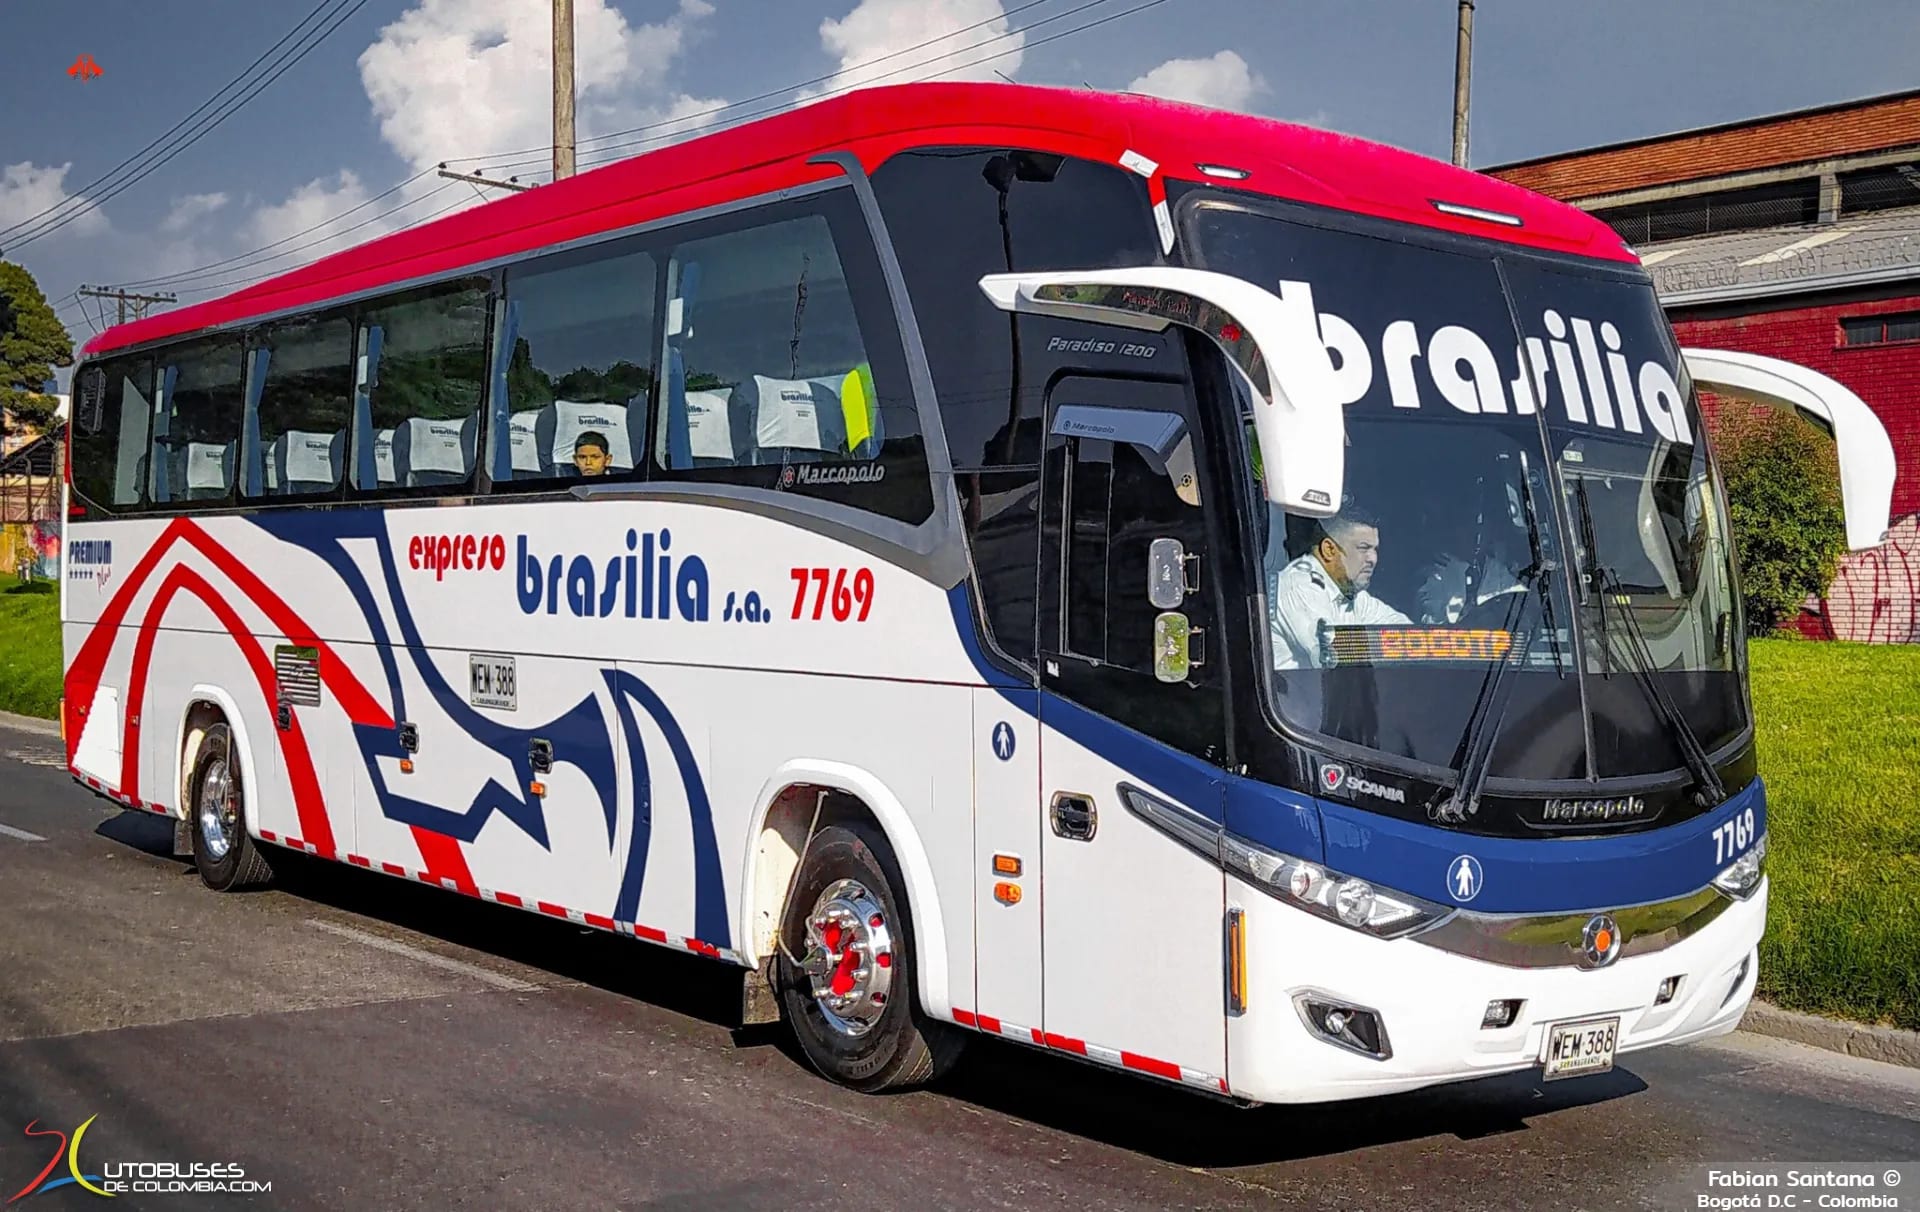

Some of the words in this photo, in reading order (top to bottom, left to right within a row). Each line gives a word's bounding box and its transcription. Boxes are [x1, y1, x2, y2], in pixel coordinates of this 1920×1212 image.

[1047, 337, 1116, 353] Paradiso
[1119, 343, 1157, 358] 1200
[1279, 279, 1694, 446] brasilia
[796, 464, 884, 485] Marcopolo
[69, 540, 112, 564] PREMIUM
[409, 534, 506, 581] expreso
[516, 528, 709, 622] brasilia
[723, 590, 771, 623] s.a.
[790, 567, 875, 622] 7769
[1346, 776, 1405, 803] SCANIA
[1543, 797, 1644, 819] Marcopolo
[1712, 808, 1755, 865] 7769
[1585, 1028, 1614, 1056] 388
